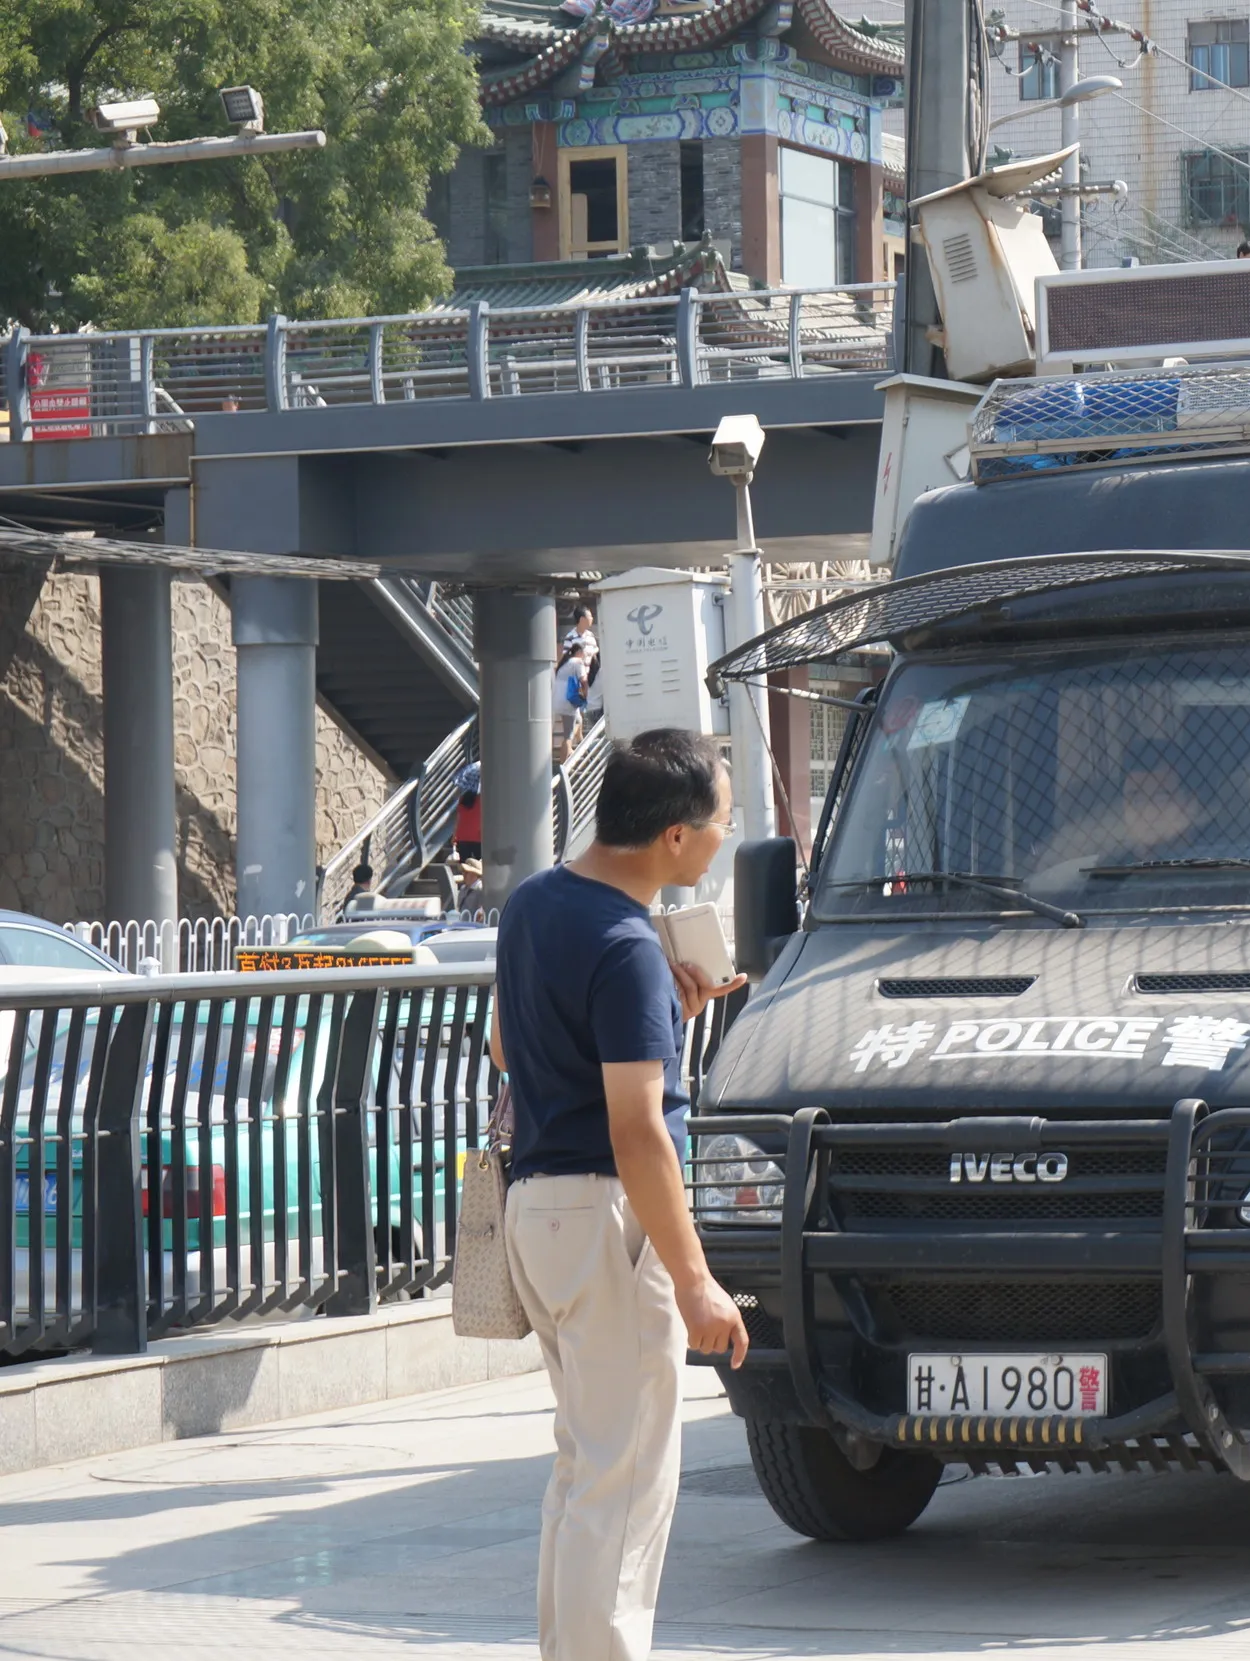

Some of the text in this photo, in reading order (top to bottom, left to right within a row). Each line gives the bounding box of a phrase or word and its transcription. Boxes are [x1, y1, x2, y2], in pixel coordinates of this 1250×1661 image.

[849, 1020, 936, 1073] 特
[932, 1020, 1159, 1054] POLICE
[950, 1153, 1069, 1182] IVECO
